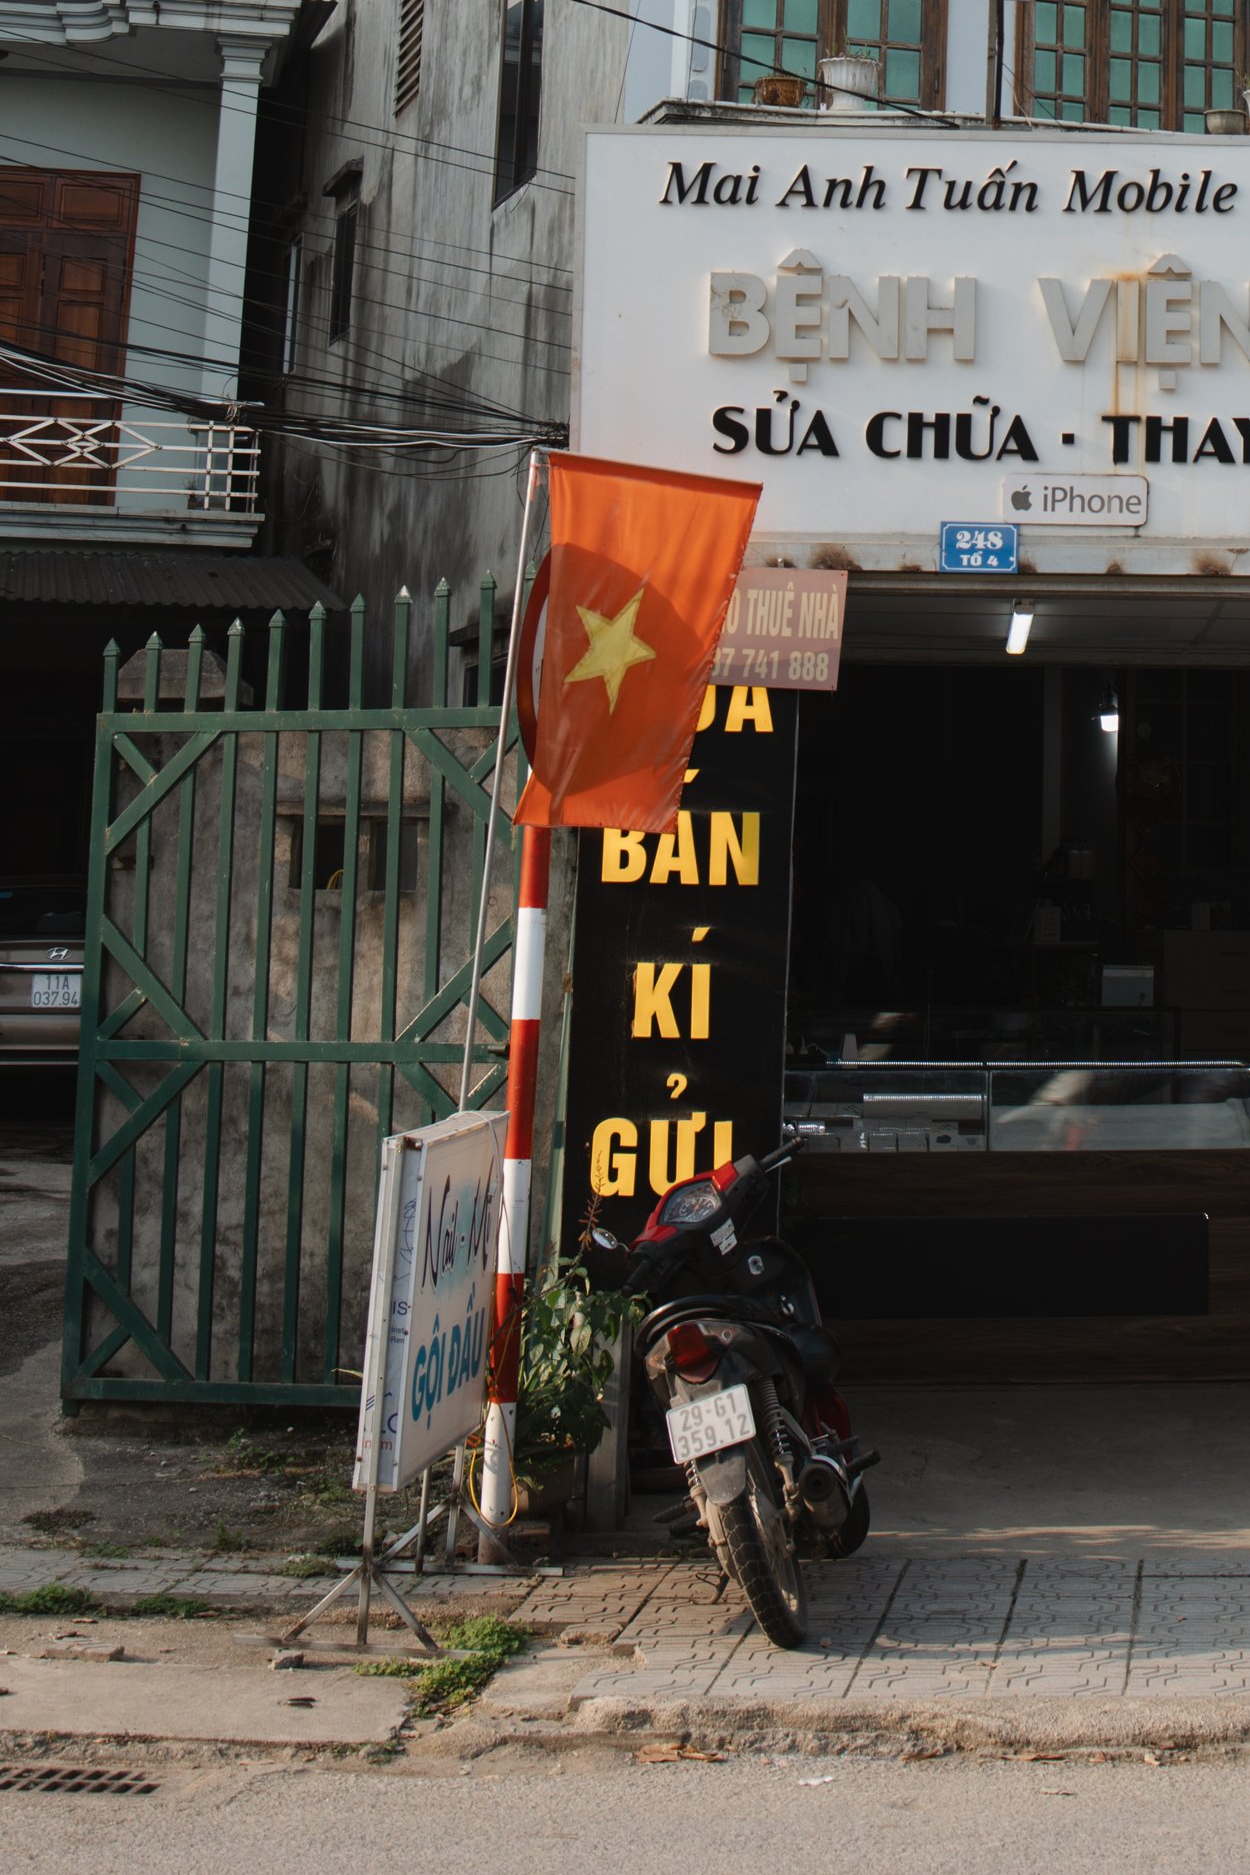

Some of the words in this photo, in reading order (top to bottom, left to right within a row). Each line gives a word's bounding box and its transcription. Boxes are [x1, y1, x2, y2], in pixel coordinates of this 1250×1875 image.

[659, 161, 761, 206] Mai
[777, 165, 886, 209] Anh
[906, 160, 1039, 213] Tuấn
[1064, 167, 1239, 214] Mobile
[709, 247, 976, 383] BỆNH
[712, 390, 839, 457] SỬA
[866, 396, 1039, 462] CHỮA
[1043, 486, 1142, 514] iPhone
[956, 530, 1003, 549] 248
[987, 555, 998, 566] 4
[746, 582, 795, 637] THUÊ
[798, 584, 839, 640] NHÀ
[742, 649, 780, 679] 741
[788, 651, 829, 682] 888
[601, 769, 760, 886] BÁN
[33, 992, 78, 1005] 037.94
[46, 976, 69, 990] 11A
[631, 927, 711, 1039] KÍ
[411, 1313, 446, 1430] GỘI
[679, 1392, 738, 1433] 29-G1
[678, 1414, 751, 1458] 359.12
